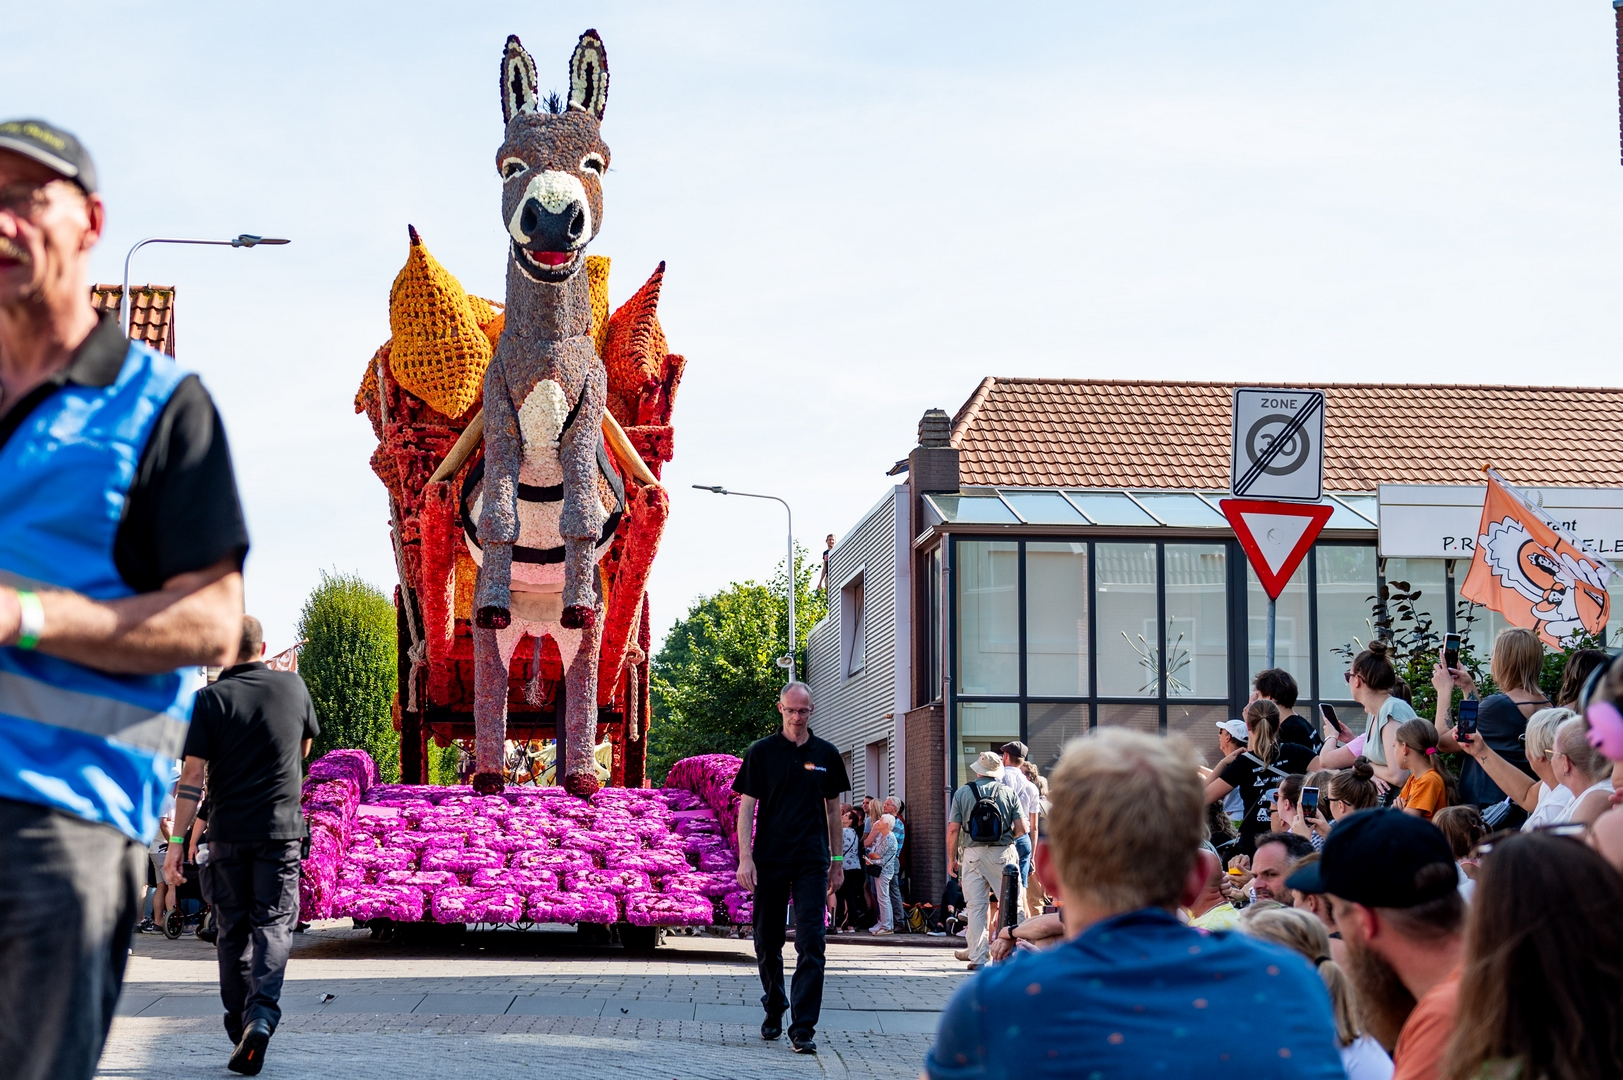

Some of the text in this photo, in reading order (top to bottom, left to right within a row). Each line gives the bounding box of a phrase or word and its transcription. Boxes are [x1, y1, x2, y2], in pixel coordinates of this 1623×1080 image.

[1260, 398, 1298, 409] ZONE
[1258, 433, 1298, 456] 30
[1543, 519, 1577, 531] rant
